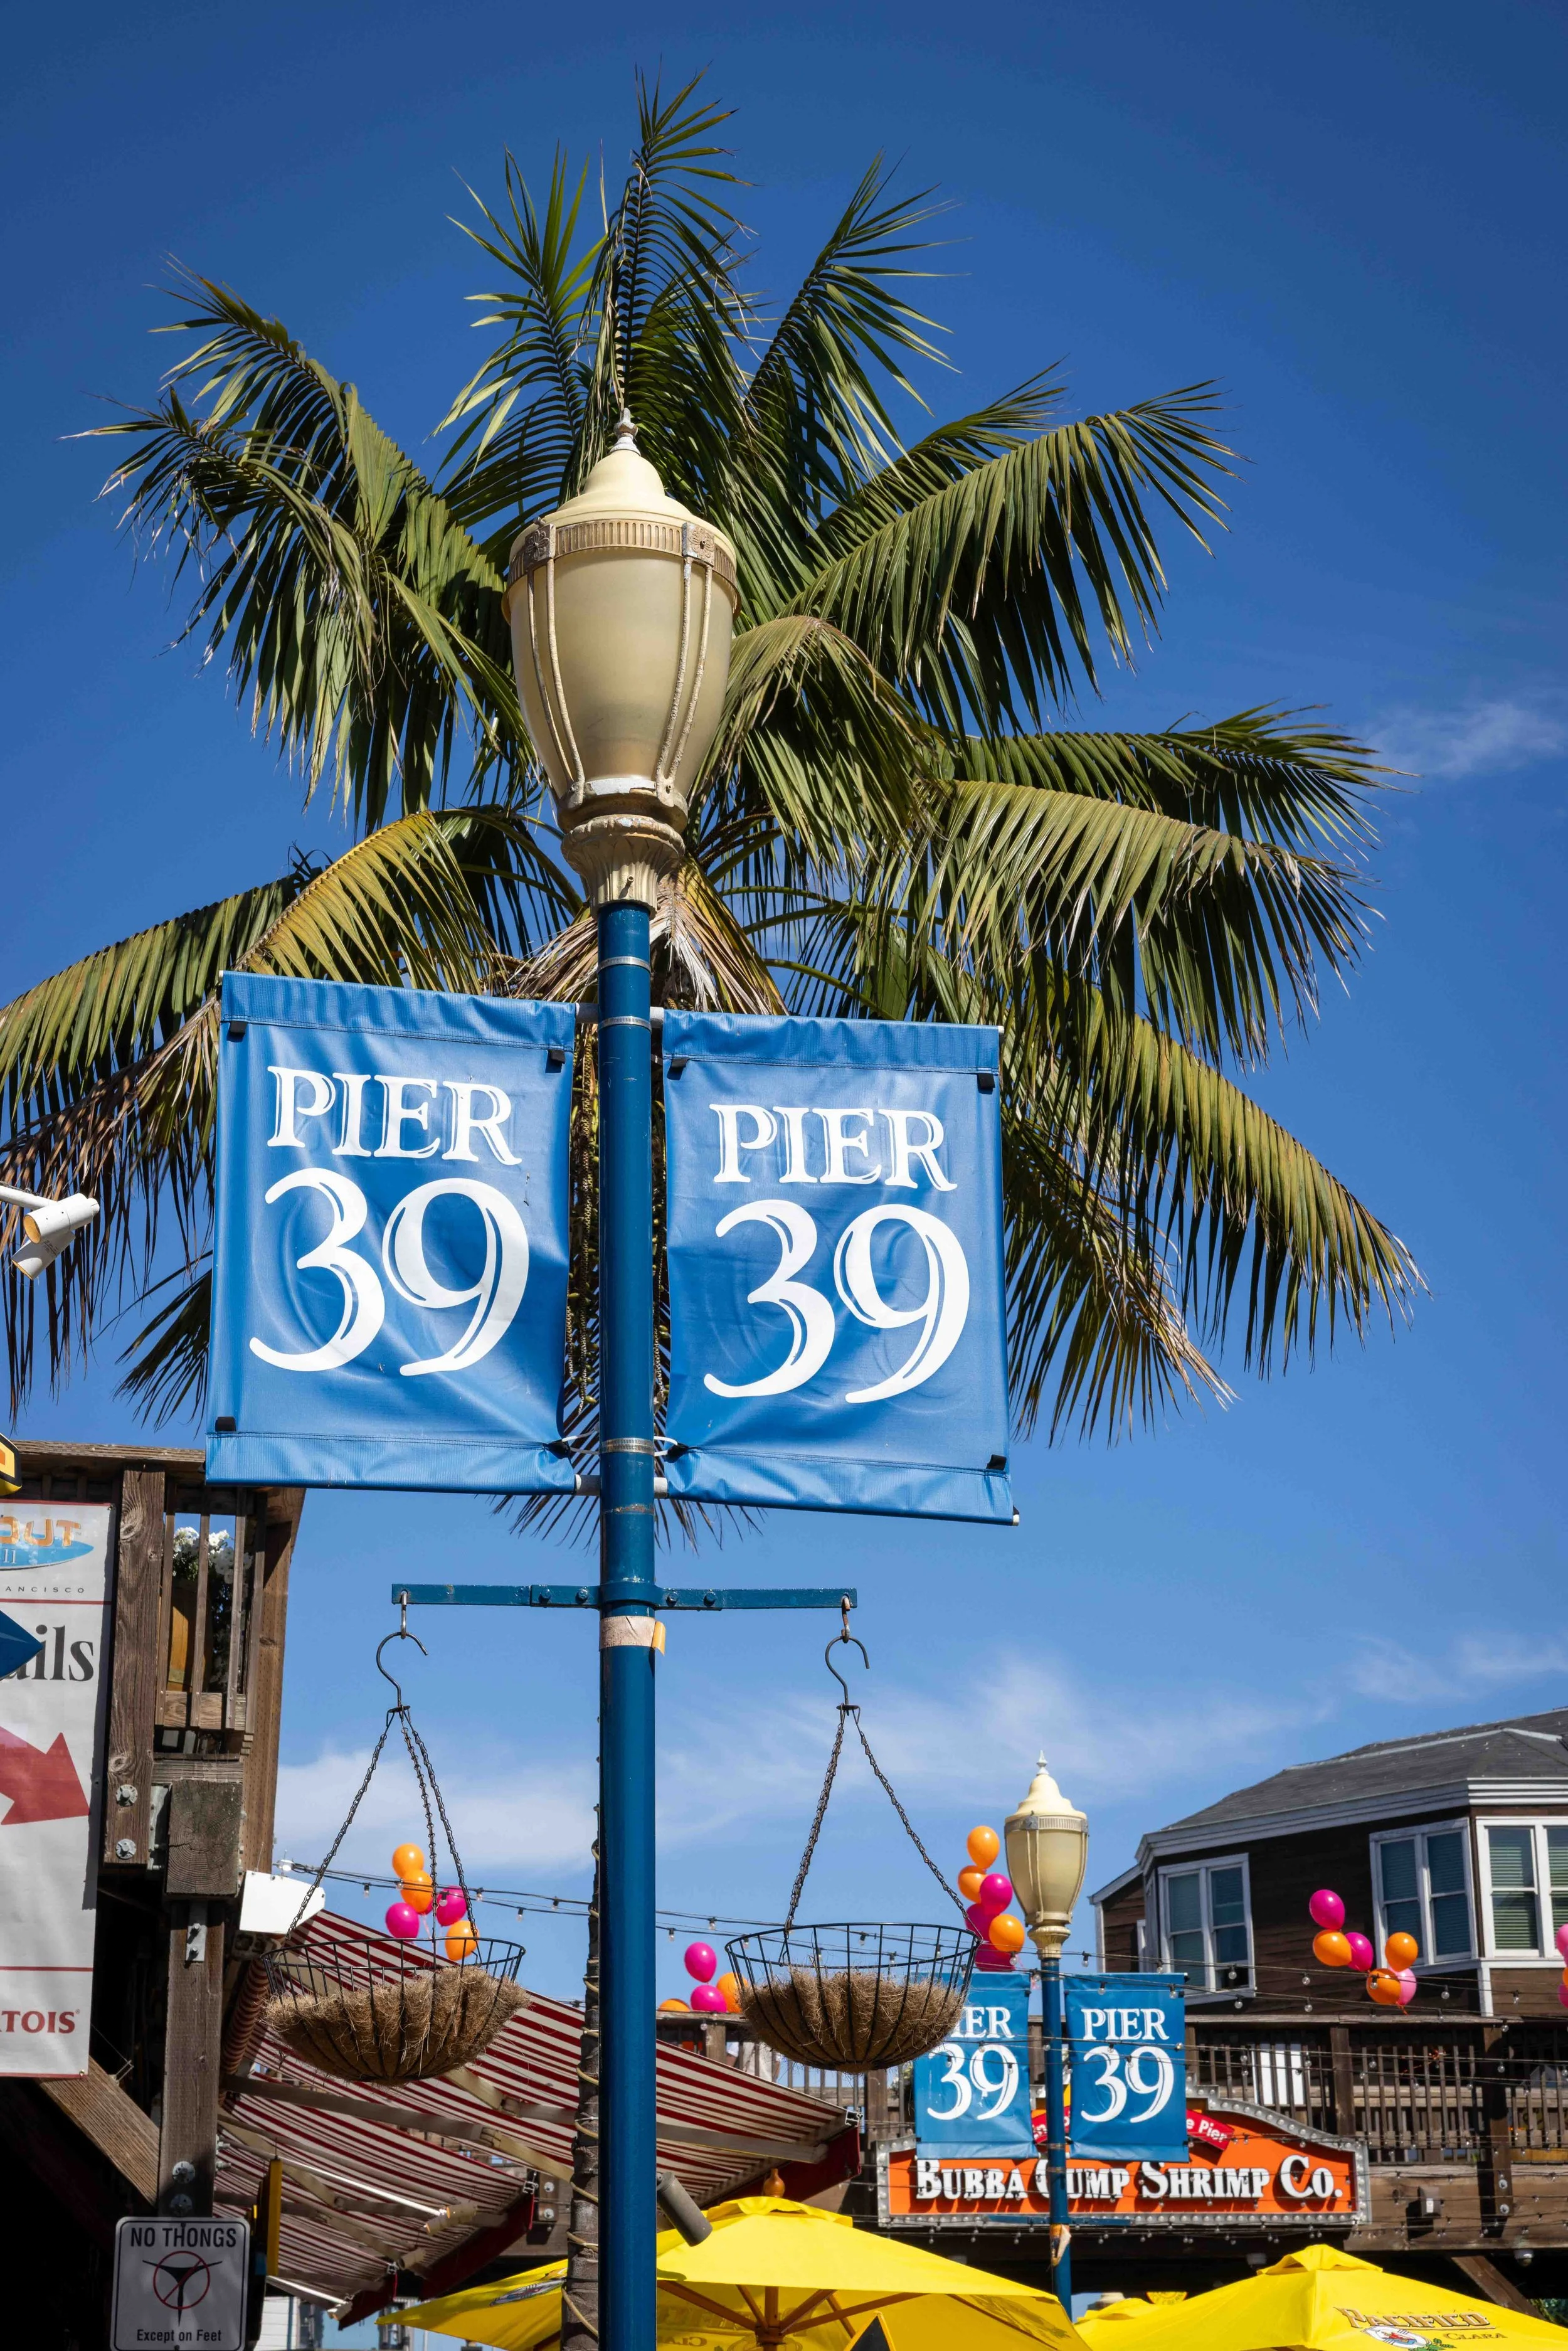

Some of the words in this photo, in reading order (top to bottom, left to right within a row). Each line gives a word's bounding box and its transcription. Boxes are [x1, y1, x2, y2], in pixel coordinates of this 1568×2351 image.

[267, 1066, 522, 1165] PIER
[709, 1103, 958, 1192] PIER
[249, 1167, 529, 1376] 39
[704, 1199, 970, 1403] 39
[3, 1624, 94, 1682] ils
[0, 2010, 75, 2034] TOIS
[1081, 2009, 1170, 2040] PIER
[927, 2042, 1019, 2120] 39
[1081, 2046, 1174, 2123] 39
[1199, 2119, 1227, 2143] Pier
[916, 2159, 1029, 2200] BUBBA
[1142, 2162, 1270, 2199] SHRIMP
[130, 2227, 156, 2248] NO
[162, 2227, 237, 2248] THONGS
[136, 2329, 175, 2343] Except
[178, 2333, 193, 2342] on
[196, 2329, 222, 2342] Feet
[1333, 2306, 1490, 2328] PACIFICO
